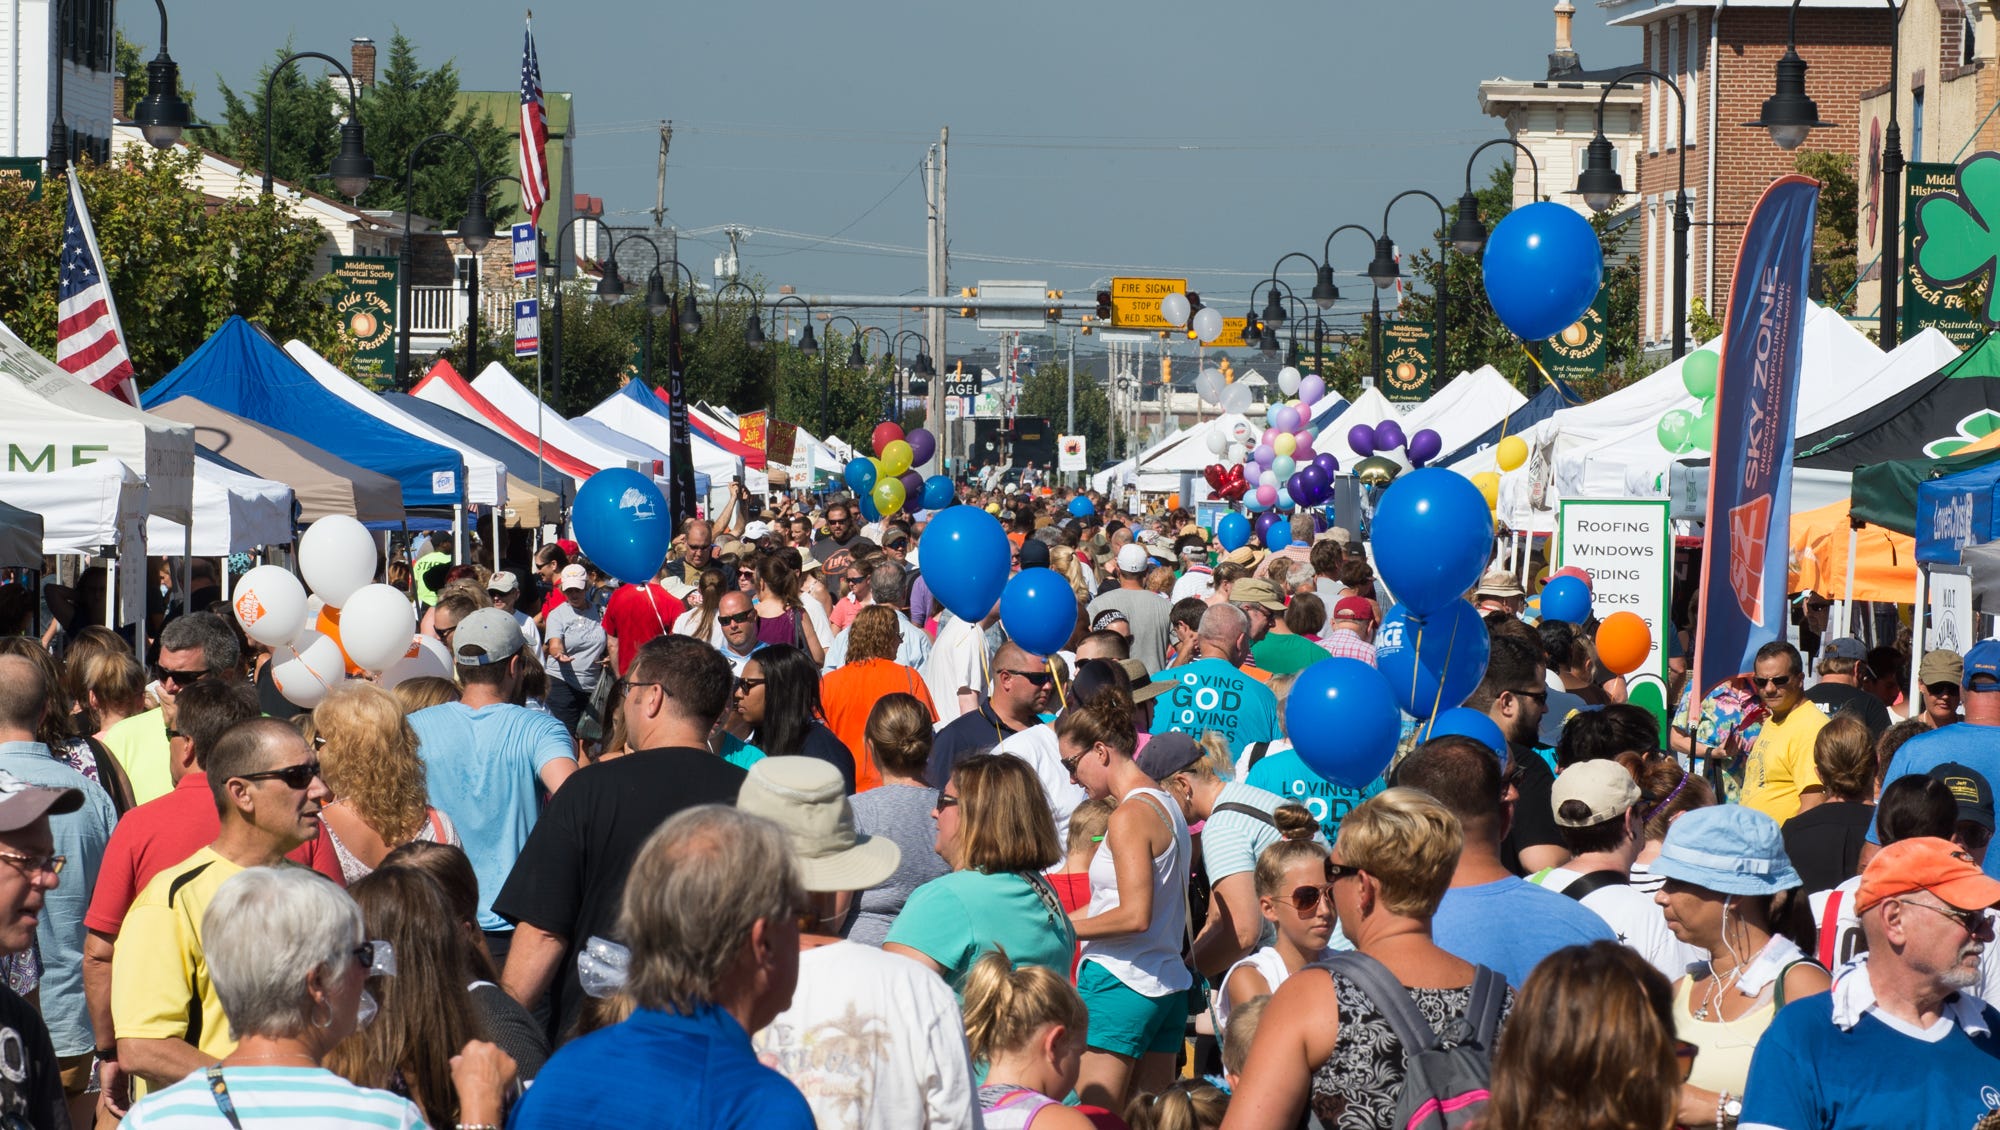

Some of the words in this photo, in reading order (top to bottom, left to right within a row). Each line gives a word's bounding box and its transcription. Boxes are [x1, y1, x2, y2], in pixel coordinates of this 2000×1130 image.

[1911, 186, 1960, 197] Historica
[345, 262, 384, 270] Middletown
[336, 269, 368, 278] Historical
[370, 270, 394, 281] Society
[1121, 283, 1140, 293] FIRE
[1145, 283, 1175, 294] SIGNAL
[338, 291, 362, 313] Olde
[364, 292, 392, 314] Tyme
[1132, 302, 1151, 311] STOP
[1124, 314, 1140, 322] RED
[1144, 314, 1167, 323] SIGNA
[1754, 266, 1779, 389] ZONE
[1918, 320, 1936, 329] 3rd
[1938, 320, 1982, 332] Saturday
[358, 321, 392, 350] Festival
[1548, 335, 1570, 356] each
[1569, 330, 1604, 359] Festival
[354, 356, 385, 364] Saturday
[1387, 347, 1405, 363] Olde
[1407, 347, 1428, 364] Tyme
[1565, 365, 1596, 373] Saturday
[1385, 368, 1402, 389] Peach
[1402, 368, 1428, 391] Festival
[1567, 372, 1584, 380] Augus
[1760, 415, 1772, 474] INDOOR
[1766, 322, 1782, 412] TRAMPOLINE
[1776, 281, 1786, 318] PARK
[1766, 285, 1792, 476] www.skyzone.com/newark
[947, 384, 980, 395] AGEL
[672, 370, 683, 444] Filter
[1745, 398, 1764, 489] SKY
[1577, 520, 1650, 533] ROOFING
[1572, 544, 1654, 556] WINDOWS
[417, 561, 438, 570] STA
[1587, 568, 1640, 580] SIDING
[1591, 592, 1640, 604] DECKS
[1172, 686, 1242, 712] GOD
[1171, 710, 1238, 728] LOVING
[1170, 726, 1236, 743] THS
[1282, 780, 1352, 796] LOVING
